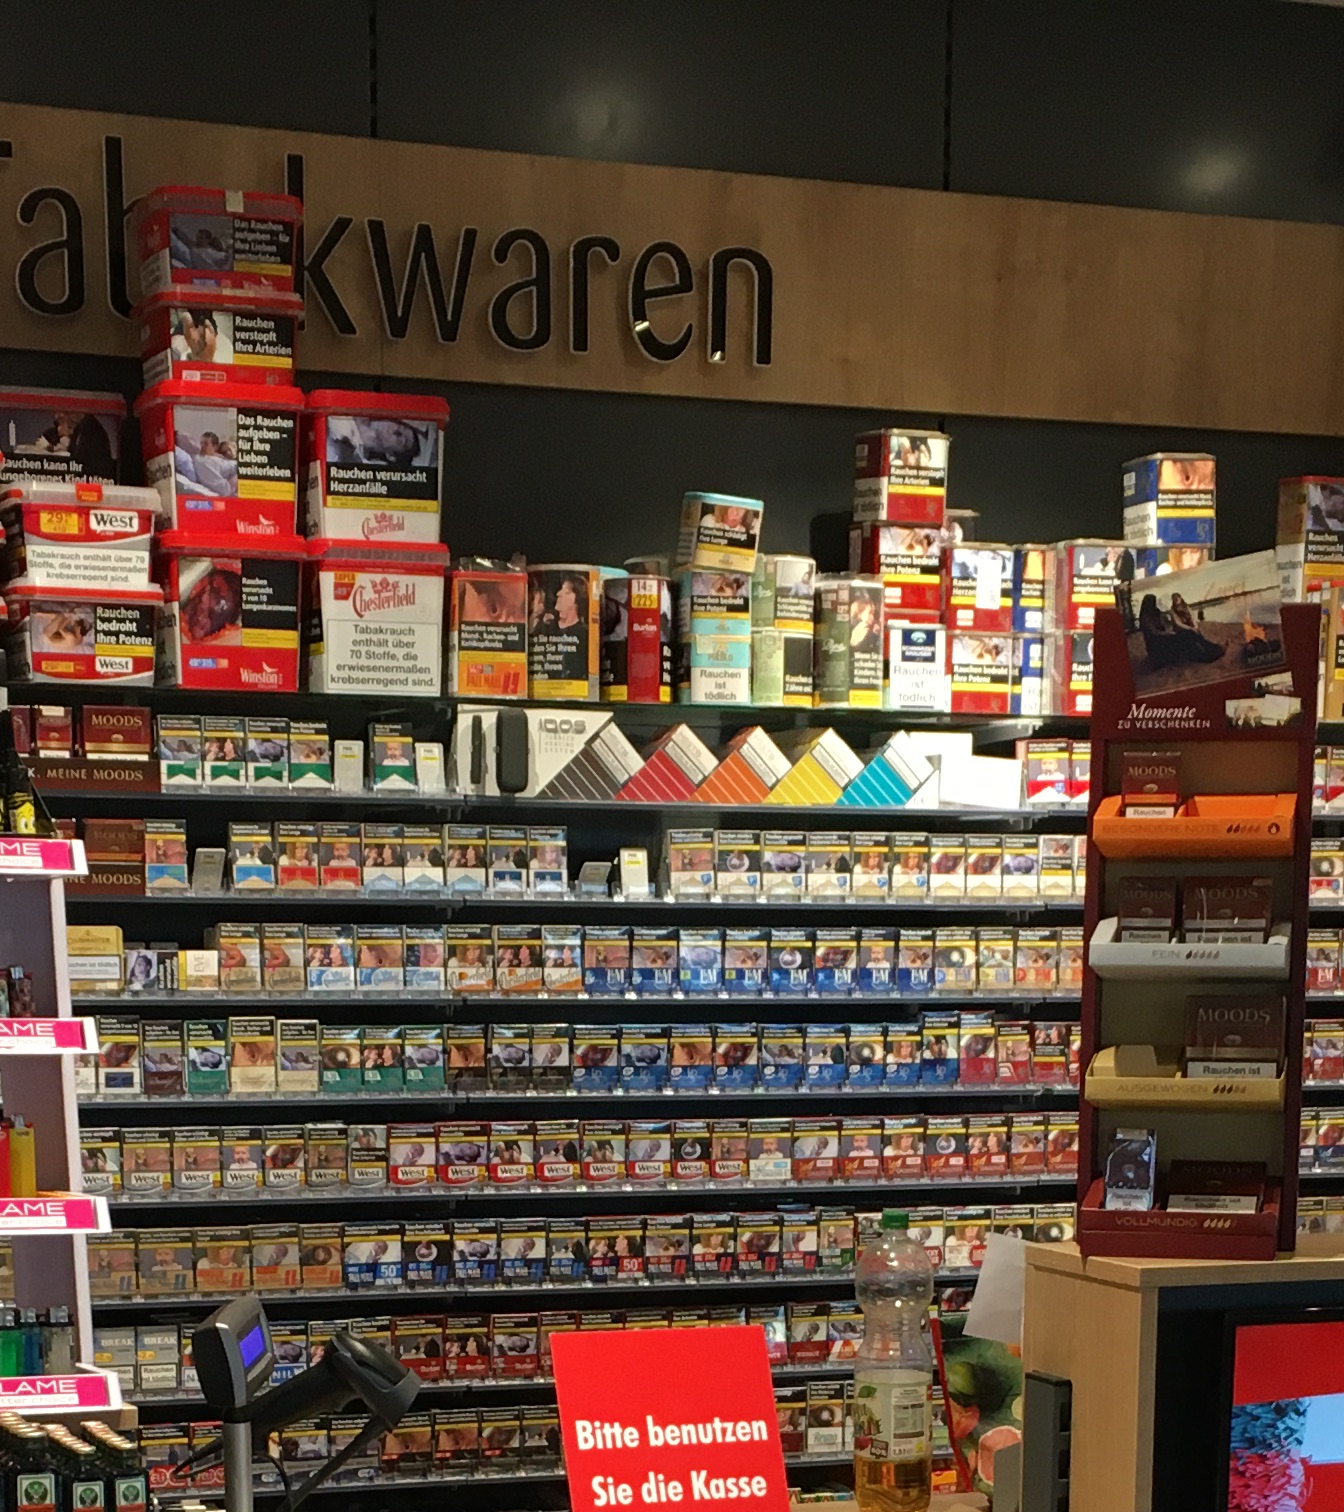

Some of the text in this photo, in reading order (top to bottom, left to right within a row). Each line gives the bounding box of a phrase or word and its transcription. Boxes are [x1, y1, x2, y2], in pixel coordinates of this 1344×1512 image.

[239, 415, 294, 428] Das Rauchen
[239, 427, 280, 439] aufgeben
[239, 439, 270, 451] für Ihre
[239, 452, 268, 463] Lieben
[239, 465, 291, 477] weiterleben
[330, 467, 427, 483] Rauchen verursacht
[330, 481, 387, 495] Herzanfälle
[94, 513, 135, 528] West
[352, 583, 416, 618] Chesterfield
[96, 607, 140, 620] Rauchen
[96, 620, 137, 632] bedroht
[353, 624, 415, 637] Tabakrauch
[96, 632, 152, 645] Ihre Potenz
[351, 637, 416, 649] enthält über
[349, 650, 418, 663] 70 Stoffe, die
[335, 663, 431, 675] erwiesenermaßen
[240, 668, 277, 684] Winston
[330, 675, 436, 688] krebserregend sind.
[1127, 703, 1197, 720] Momente
[91, 714, 143, 726] MOODS
[1117, 719, 1211, 730] ZU VERSCHENKEN
[47, 768, 143, 781] MEINE MOODS
[1128, 765, 1177, 777] MOODS
[1152, 949, 1180, 959] FEIN
[1198, 1006, 1271, 1024] MOODS
[1116, 1083, 1208, 1094] AUSGEWOGEN
[1115, 1215, 1198, 1228] VOLLMUNDIG
[575, 1415, 768, 1450] Bitte benutzen
[591, 1469, 767, 1507] Sie die Kasse
